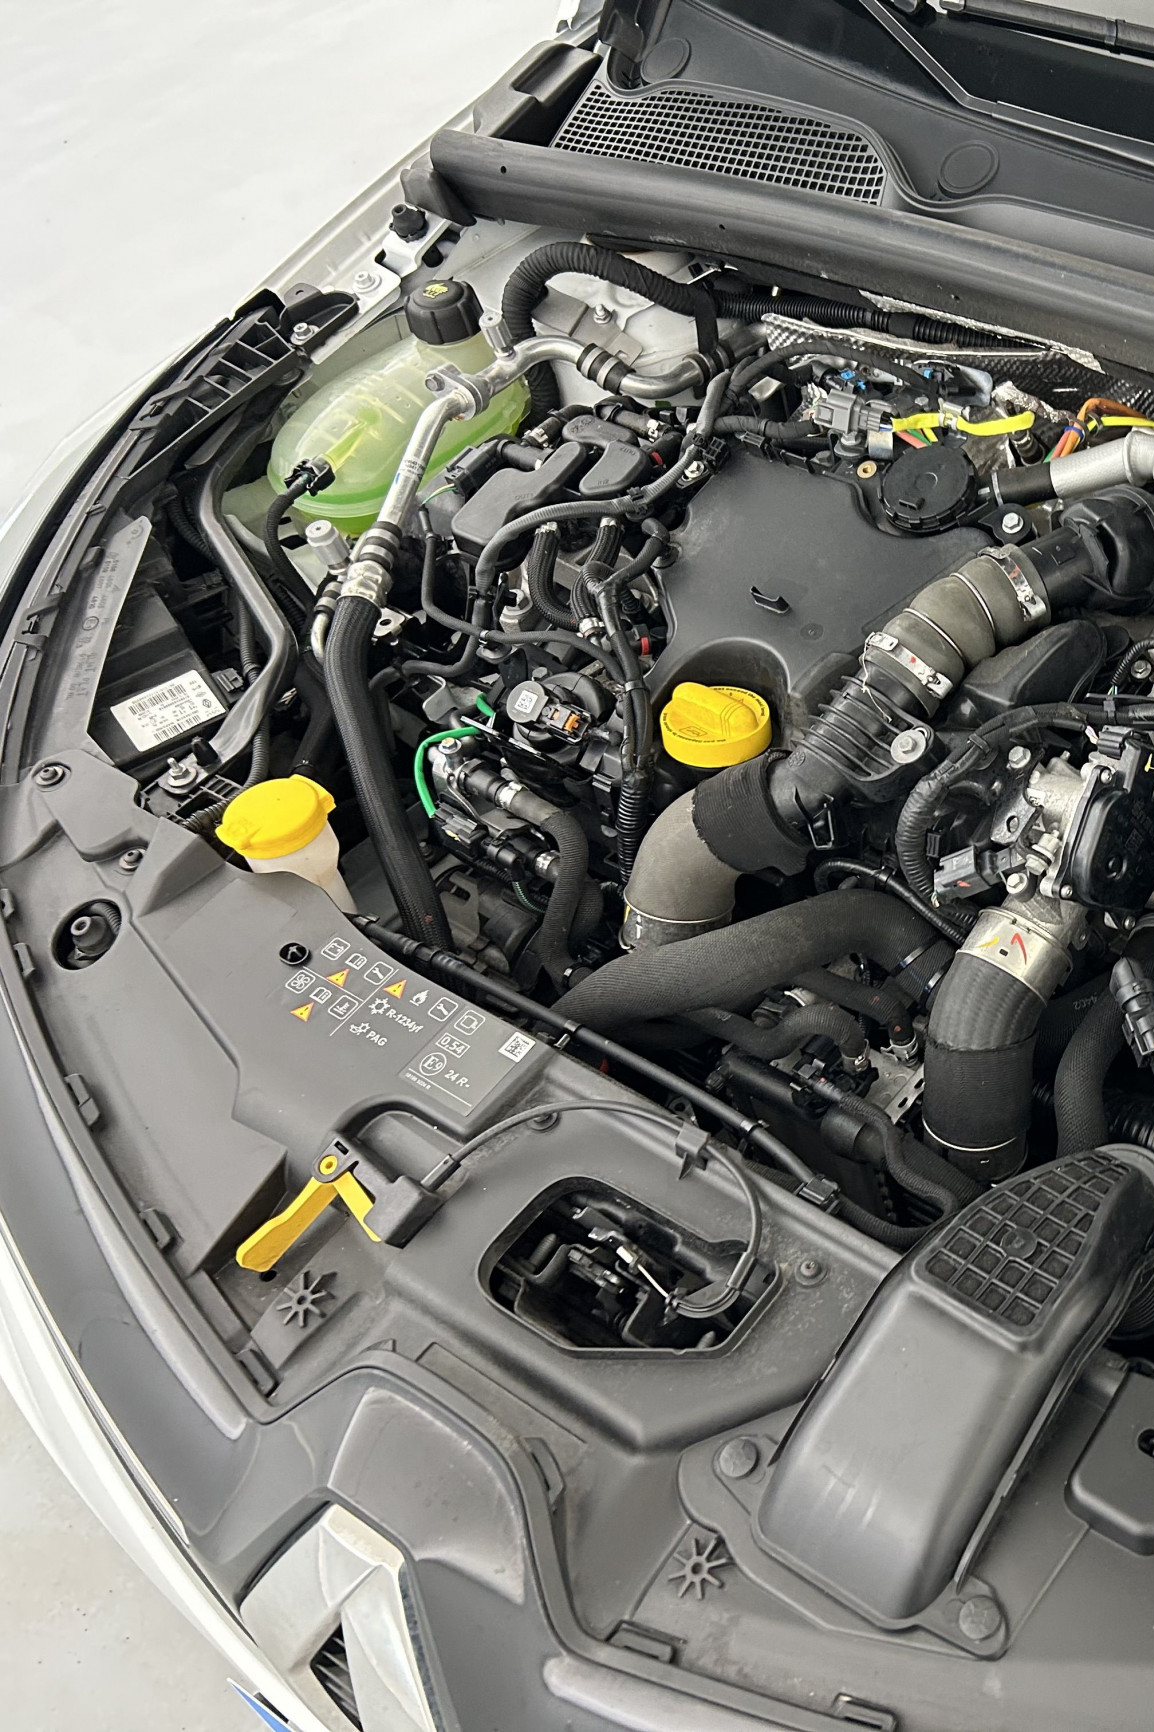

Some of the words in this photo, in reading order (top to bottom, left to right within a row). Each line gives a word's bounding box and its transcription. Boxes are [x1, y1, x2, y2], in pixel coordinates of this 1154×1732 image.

[385, 1007, 425, 1033] R-1234yf
[366, 1029, 388, 1047] PAG
[440, 1036, 465, 1056] 0,54
[424, 1056, 443, 1073] E9
[444, 1068, 459, 1085] 24
